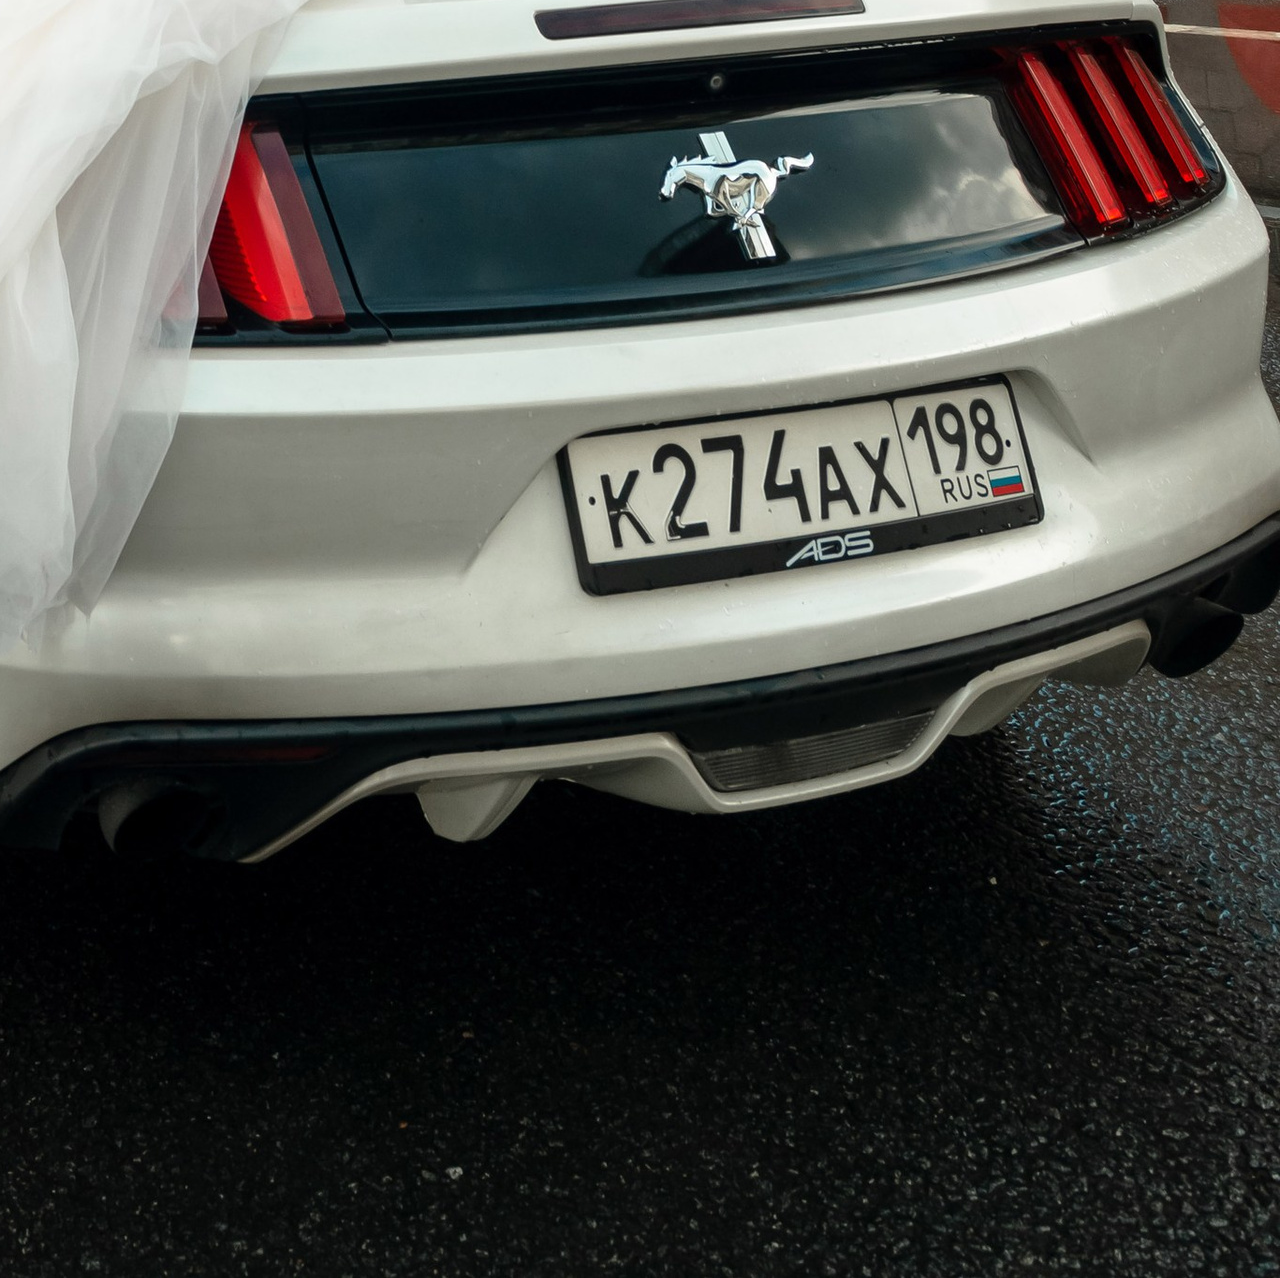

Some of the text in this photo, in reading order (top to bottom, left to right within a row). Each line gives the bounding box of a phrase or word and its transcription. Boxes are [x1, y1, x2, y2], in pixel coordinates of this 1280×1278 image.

[600, 398, 1005, 549] К274АХ 198
[941, 473, 989, 504] RUS
[785, 530, 874, 567] ADS
